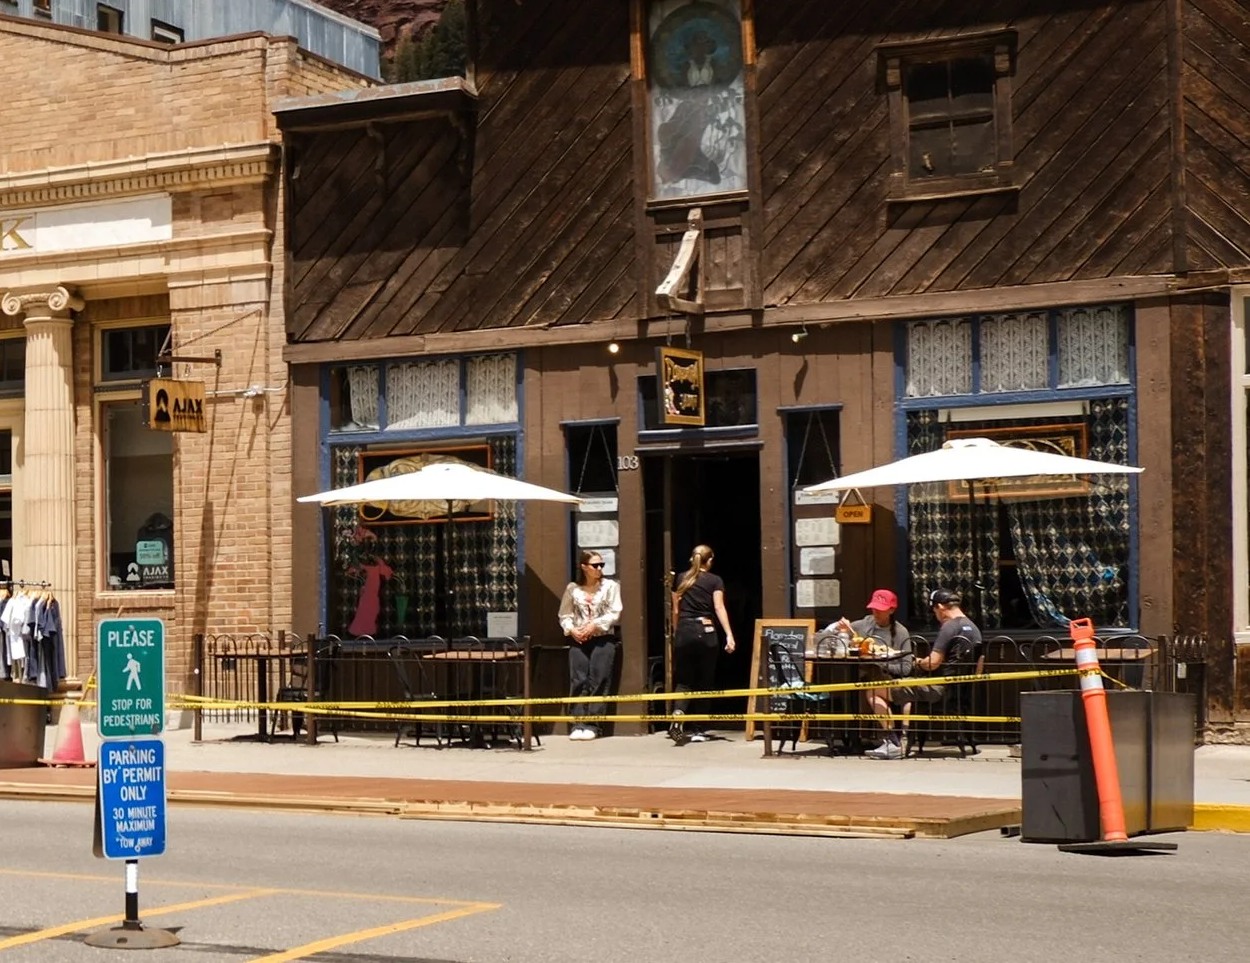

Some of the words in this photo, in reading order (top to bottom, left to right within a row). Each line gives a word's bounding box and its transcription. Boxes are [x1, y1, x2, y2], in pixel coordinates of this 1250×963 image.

[173, 398, 203, 413] AJAX
[617, 456, 639, 470] 103
[843, 510, 863, 518] OPEN
[143, 566, 169, 575] AJAX
[108, 630, 155, 647] PLEASE
[112, 699, 132, 711] STOP
[136, 698, 152, 710] FOR
[103, 714, 160, 727] PEDESTRIANS
[109, 749, 156, 766] PARKING
[103, 768, 118, 784] BY
[122, 766, 162, 783] PERMIT
[120, 785, 147, 802] ONLY
[112, 807, 124, 819] 30
[128, 805, 157, 819] MINUTE
[116, 819, 155, 833] MAXIMUM
[137, 837, 153, 847] AWAY
